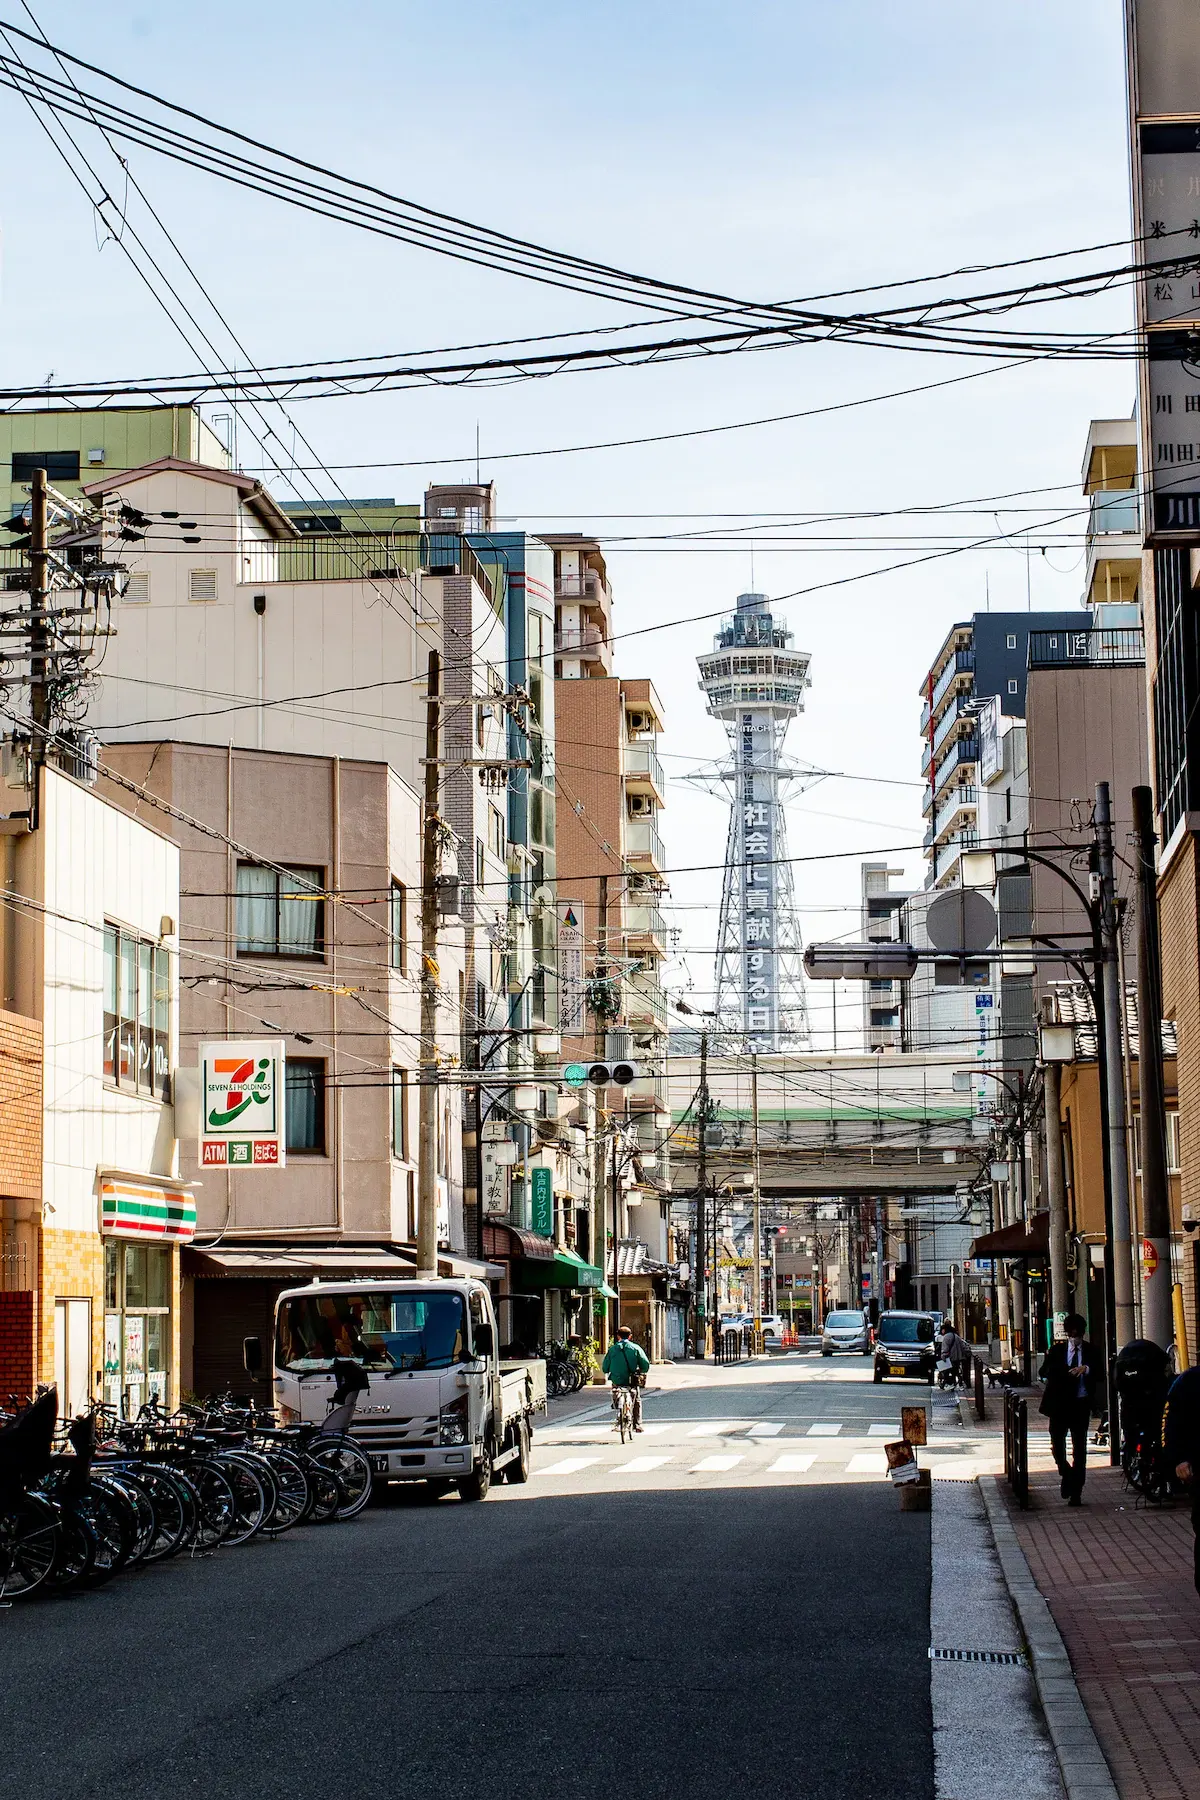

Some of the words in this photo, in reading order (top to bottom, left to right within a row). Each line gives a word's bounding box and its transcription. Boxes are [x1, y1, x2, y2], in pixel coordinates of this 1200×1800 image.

[204, 1144, 226, 1161] ATM
[233, 1144, 248, 1162] 酒
[254, 1143, 278, 1161] たばこ
[353, 1404, 391, 1415] SUZU
